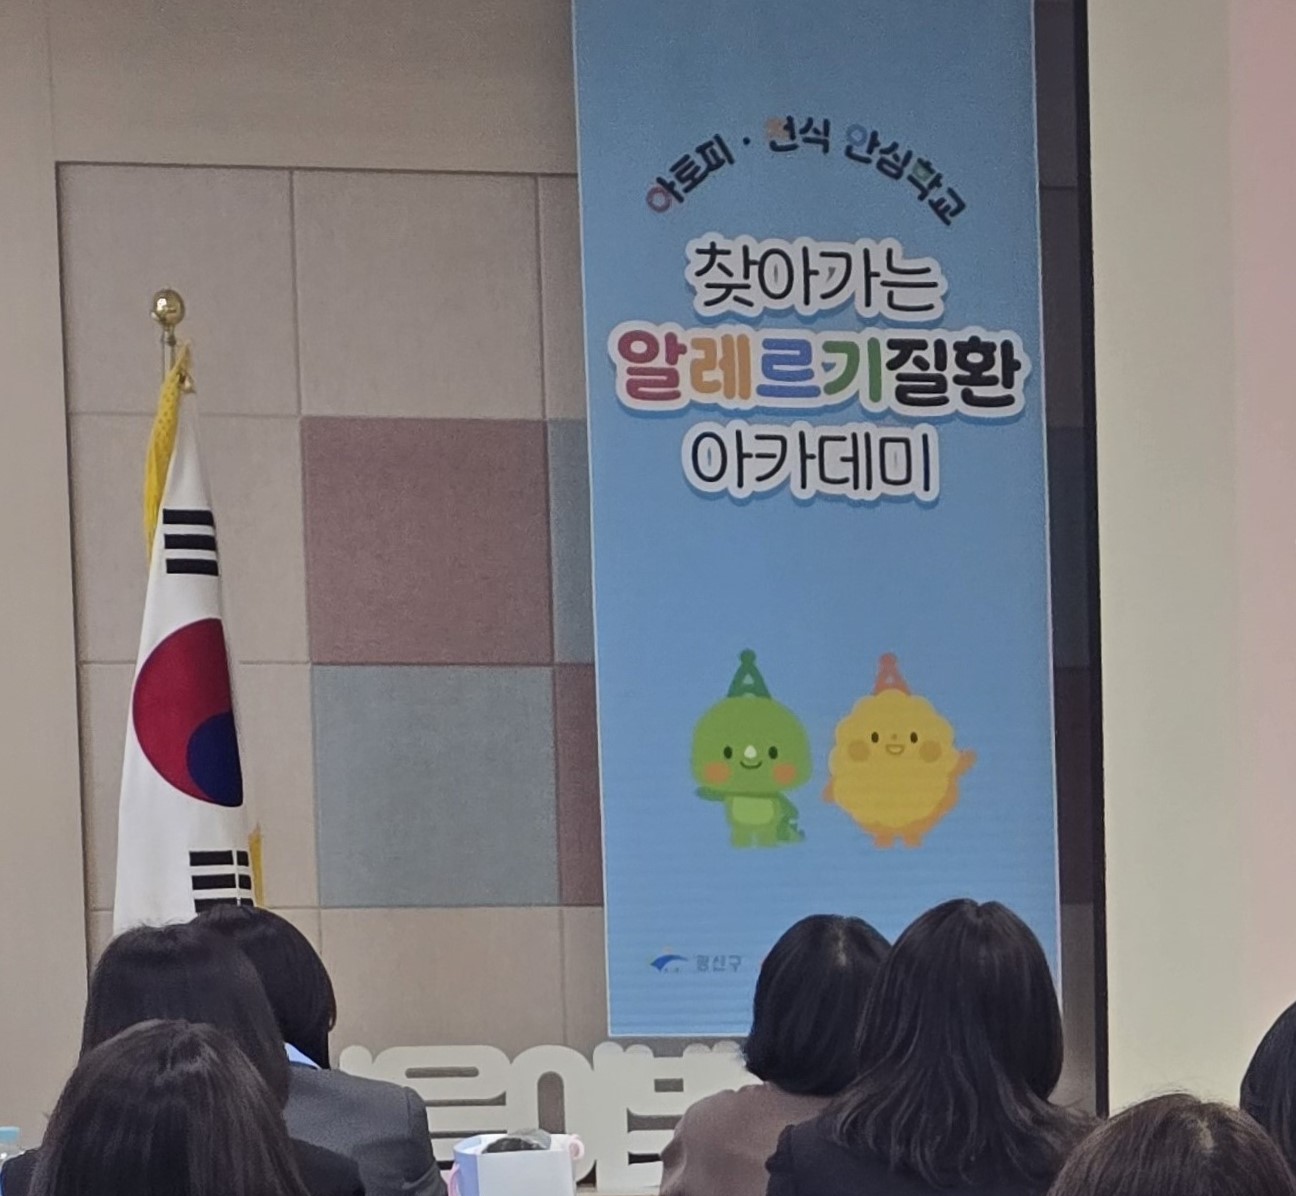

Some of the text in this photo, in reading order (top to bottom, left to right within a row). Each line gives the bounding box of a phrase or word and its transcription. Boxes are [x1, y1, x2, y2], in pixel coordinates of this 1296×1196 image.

[845, 124, 967, 226] 안심학교
[695, 241, 939, 312] 찾아가는
[617, 329, 1022, 408] 알레르기질환
[691, 429, 931, 492] 아카데미
